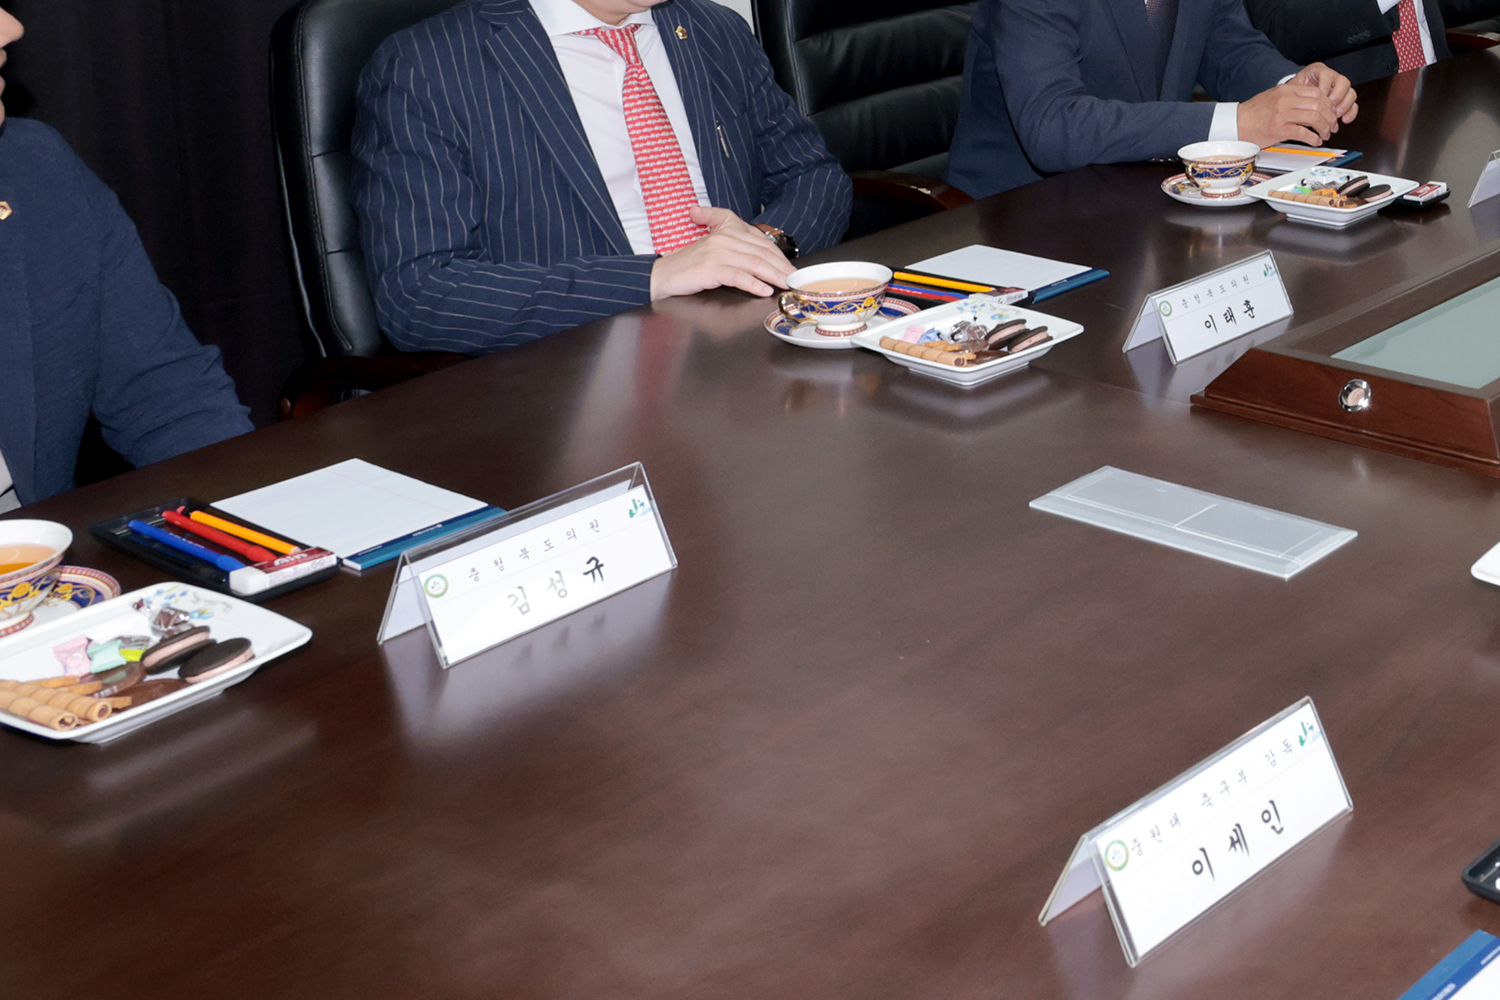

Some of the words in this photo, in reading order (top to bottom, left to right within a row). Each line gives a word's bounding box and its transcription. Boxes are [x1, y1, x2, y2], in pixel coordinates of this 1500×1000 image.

[1180, 274, 1252, 309] 충청북도의원
[1204, 299, 1256, 334] 이태훈
[467, 518, 601, 582] 충청북도의원
[506, 555, 605, 616] 김성규
[1130, 811, 1182, 857] 중원대
[1201, 768, 1249, 808] 축구부
[1264, 738, 1294, 768] 감독
[1191, 799, 1285, 882] 이세인
